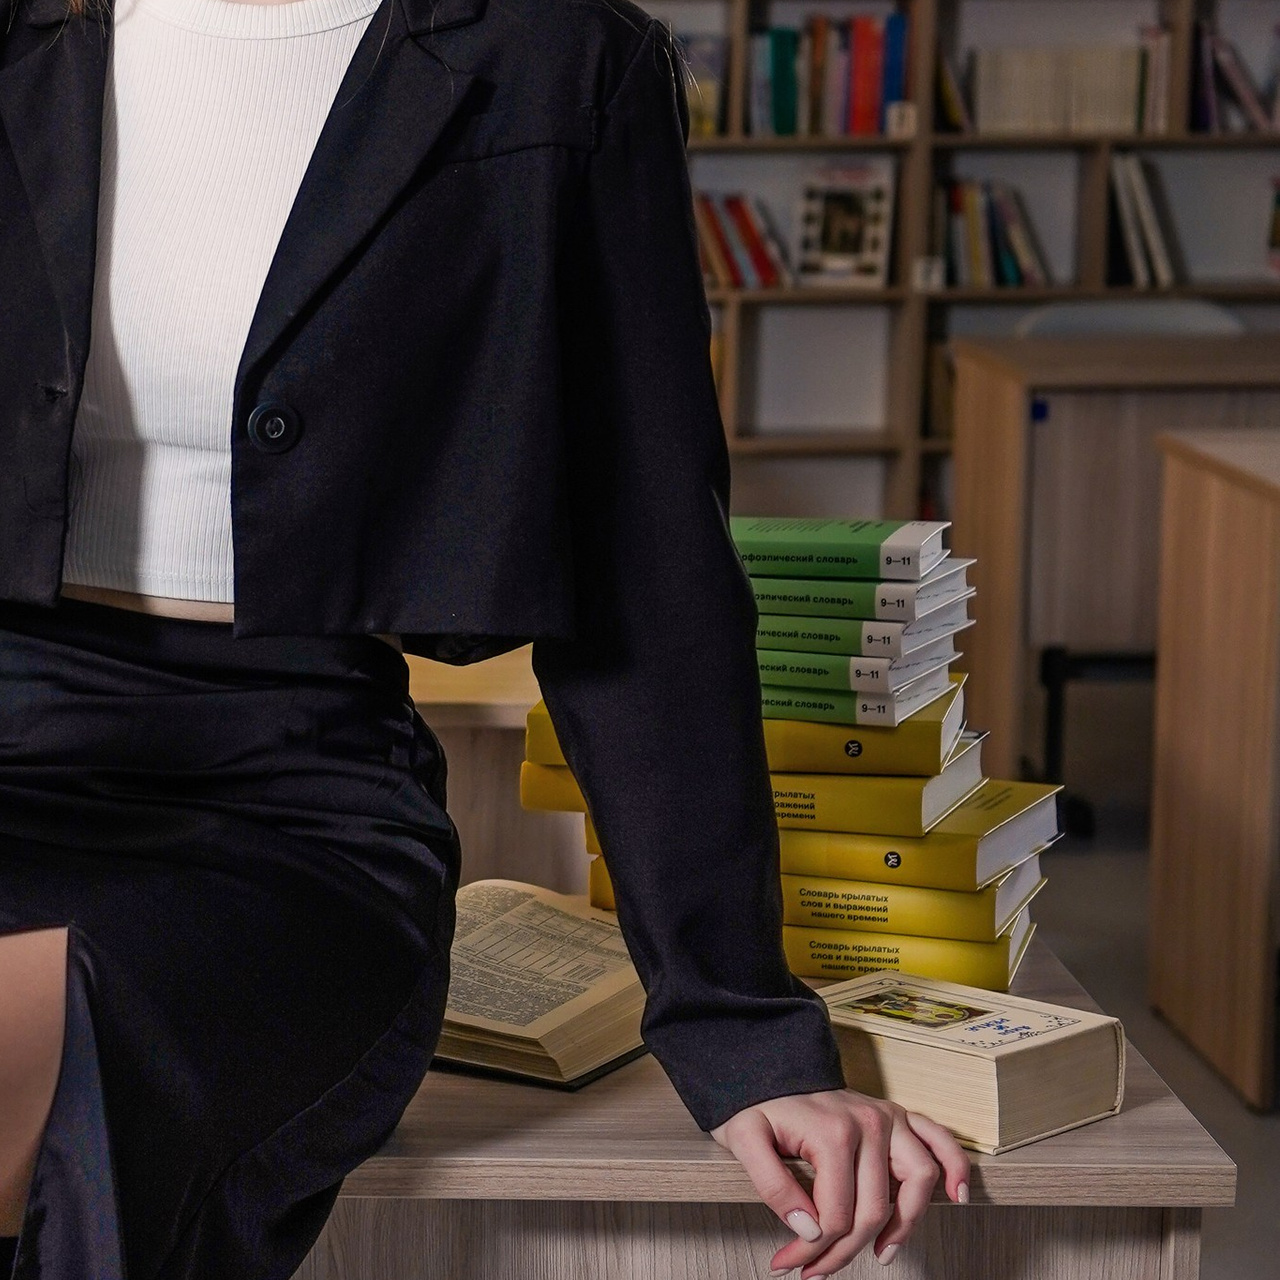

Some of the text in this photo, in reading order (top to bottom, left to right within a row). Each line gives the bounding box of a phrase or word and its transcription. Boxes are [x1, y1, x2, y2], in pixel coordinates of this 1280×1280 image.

[816, 554, 858, 565] словарь
[755, 593, 854, 606] оэпический словарь
[801, 632, 841, 643] словарь
[760, 664, 830, 676] еский словарь
[762, 699, 835, 711] еский словарь
[774, 791, 815, 800] рылатых
[775, 801, 815, 810] ражений
[800, 888, 889, 902] Словарь крылатых
[833, 903, 888, 913] выражений
[811, 911, 888, 923] нашего времени
[809, 941, 900, 954] Словарь крылатых
[844, 954, 899, 964] выражений
[822, 963, 856, 971] нашего
